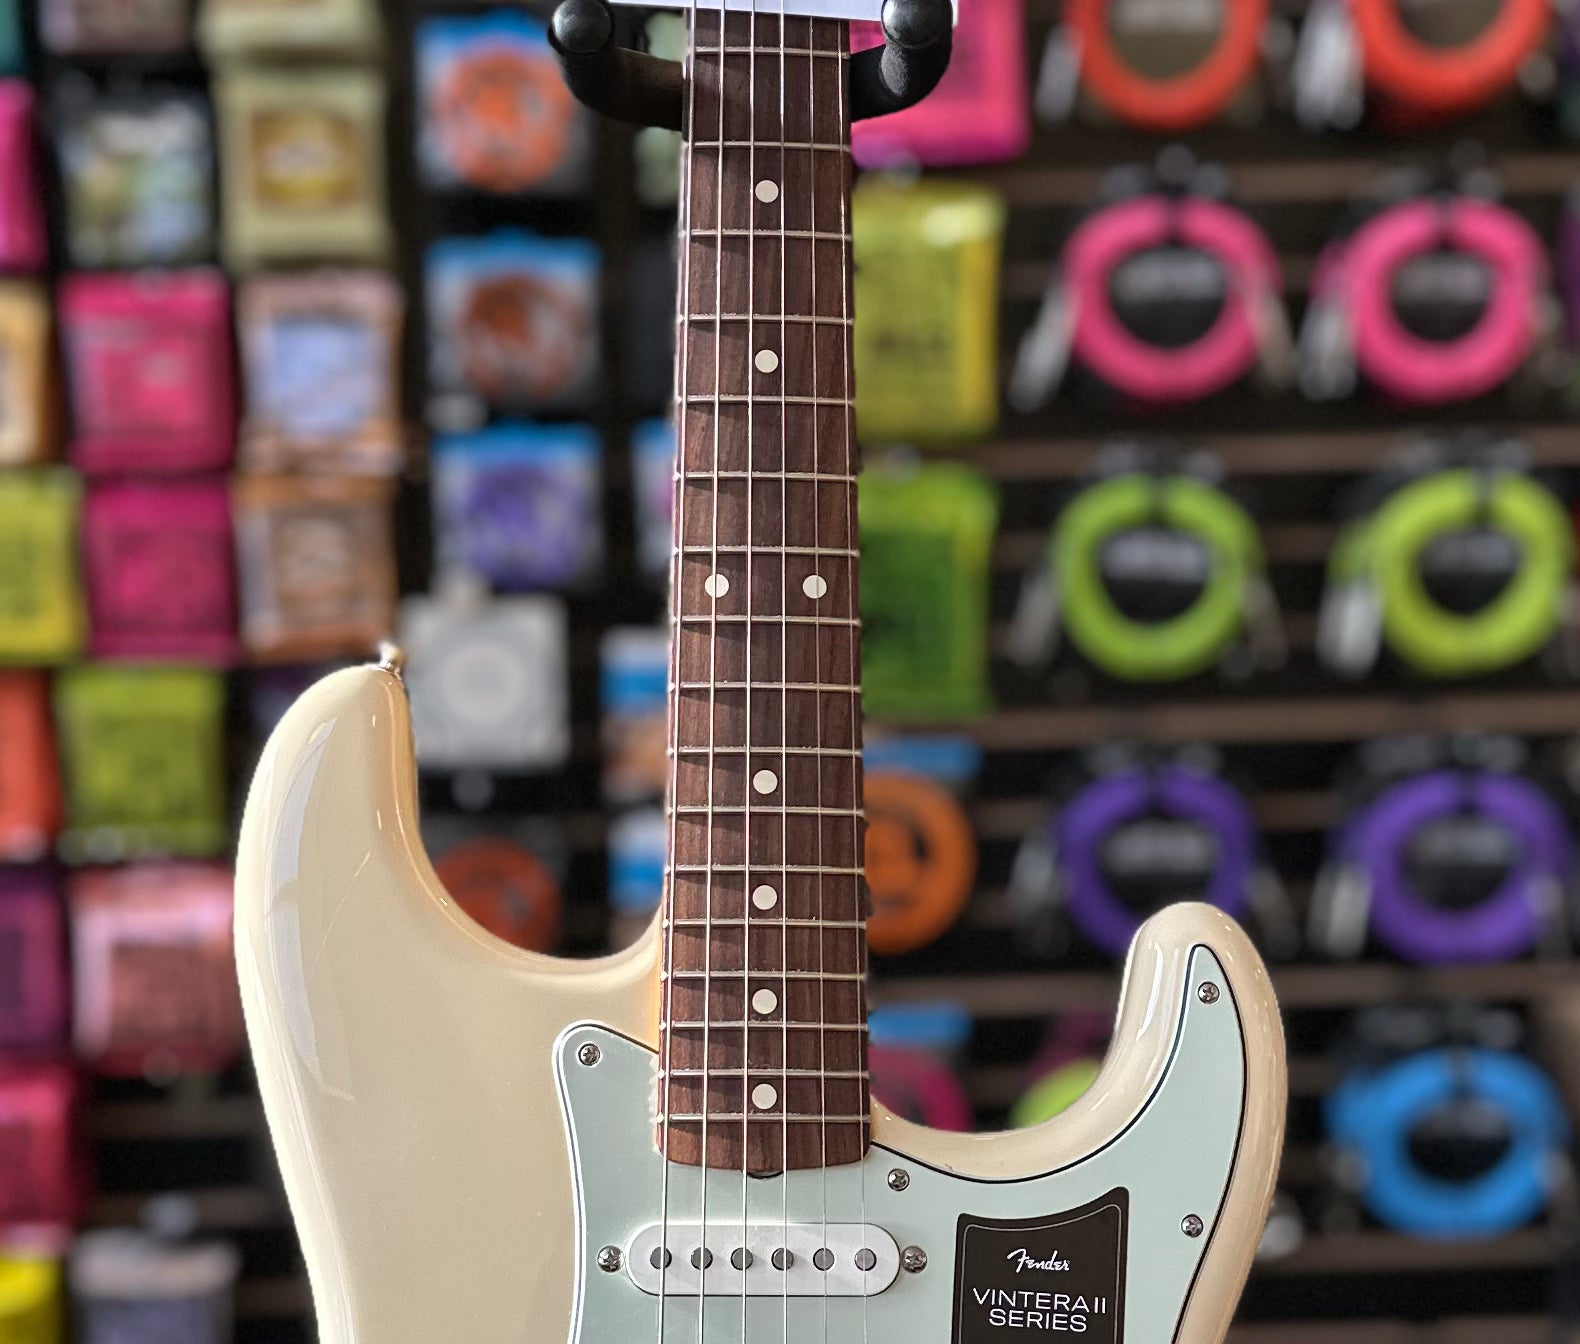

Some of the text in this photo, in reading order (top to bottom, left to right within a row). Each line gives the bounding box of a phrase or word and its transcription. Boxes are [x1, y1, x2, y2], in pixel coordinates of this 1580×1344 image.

[1006, 1248, 1070, 1274] Fender
[972, 1287, 1106, 1314] VINTERA II
[988, 1308, 1087, 1333] SERIES
